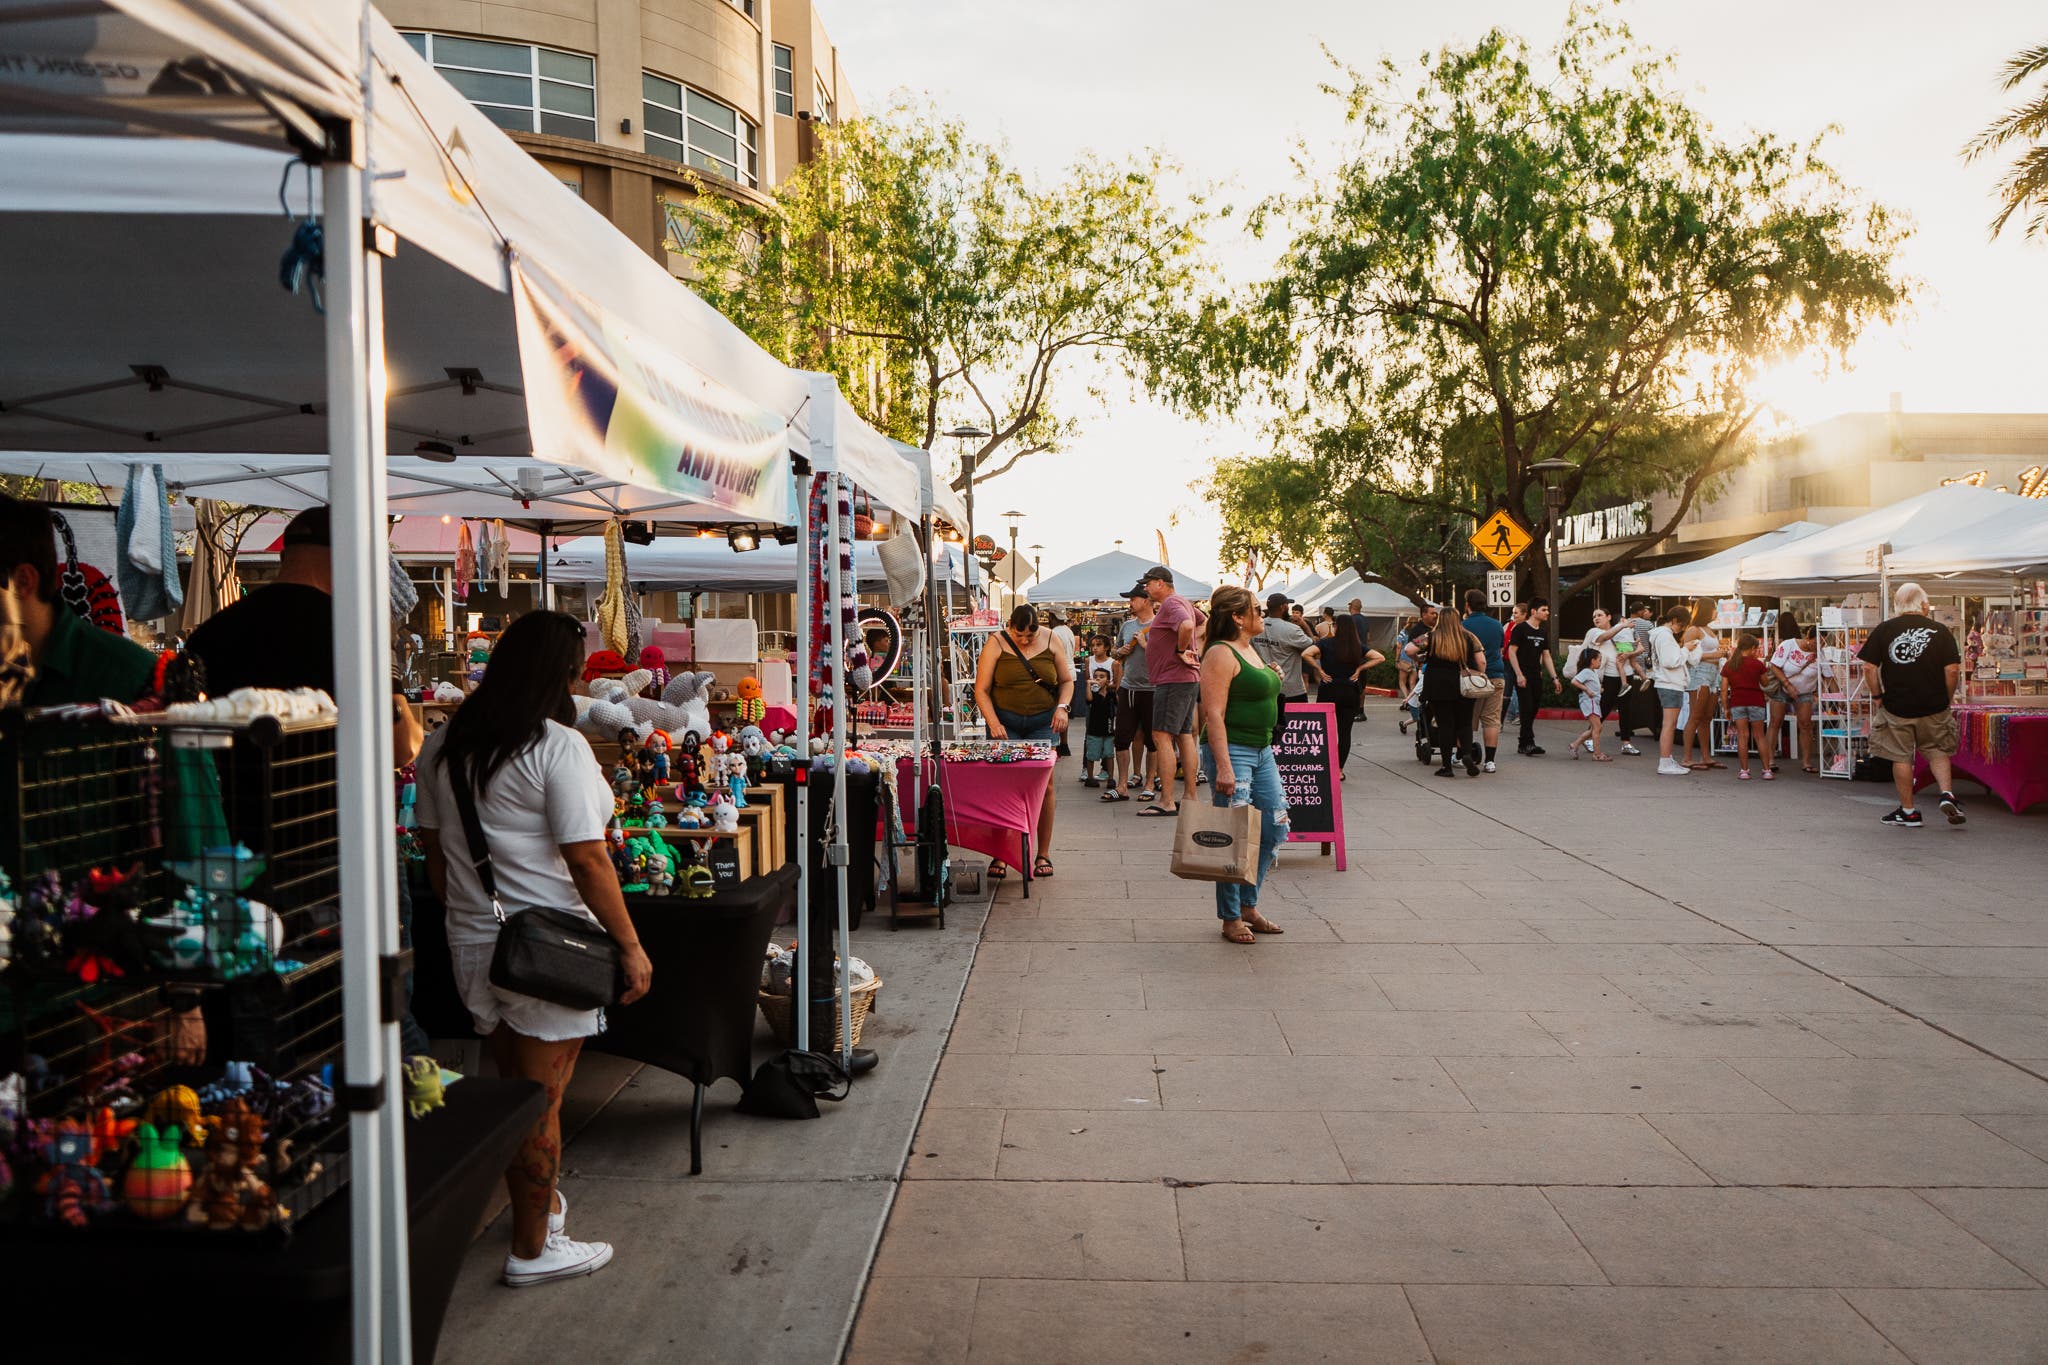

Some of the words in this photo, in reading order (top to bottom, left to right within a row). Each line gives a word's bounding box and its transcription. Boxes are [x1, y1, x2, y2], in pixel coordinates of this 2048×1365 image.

[676, 441, 716, 481] AND
[1573, 512, 1603, 545] WILD
[1604, 501, 1647, 540] WINGS
[1492, 590, 1511, 602] 10
[1286, 719, 1323, 731] arm
[1281, 732, 1324, 746] GLAM
[1284, 747, 1308, 755] SHOP
[1289, 775, 1316, 784] EACH
[1303, 785, 1319, 795] $10
[1304, 796, 1322, 805] $20
[715, 862, 735, 870] Thank
